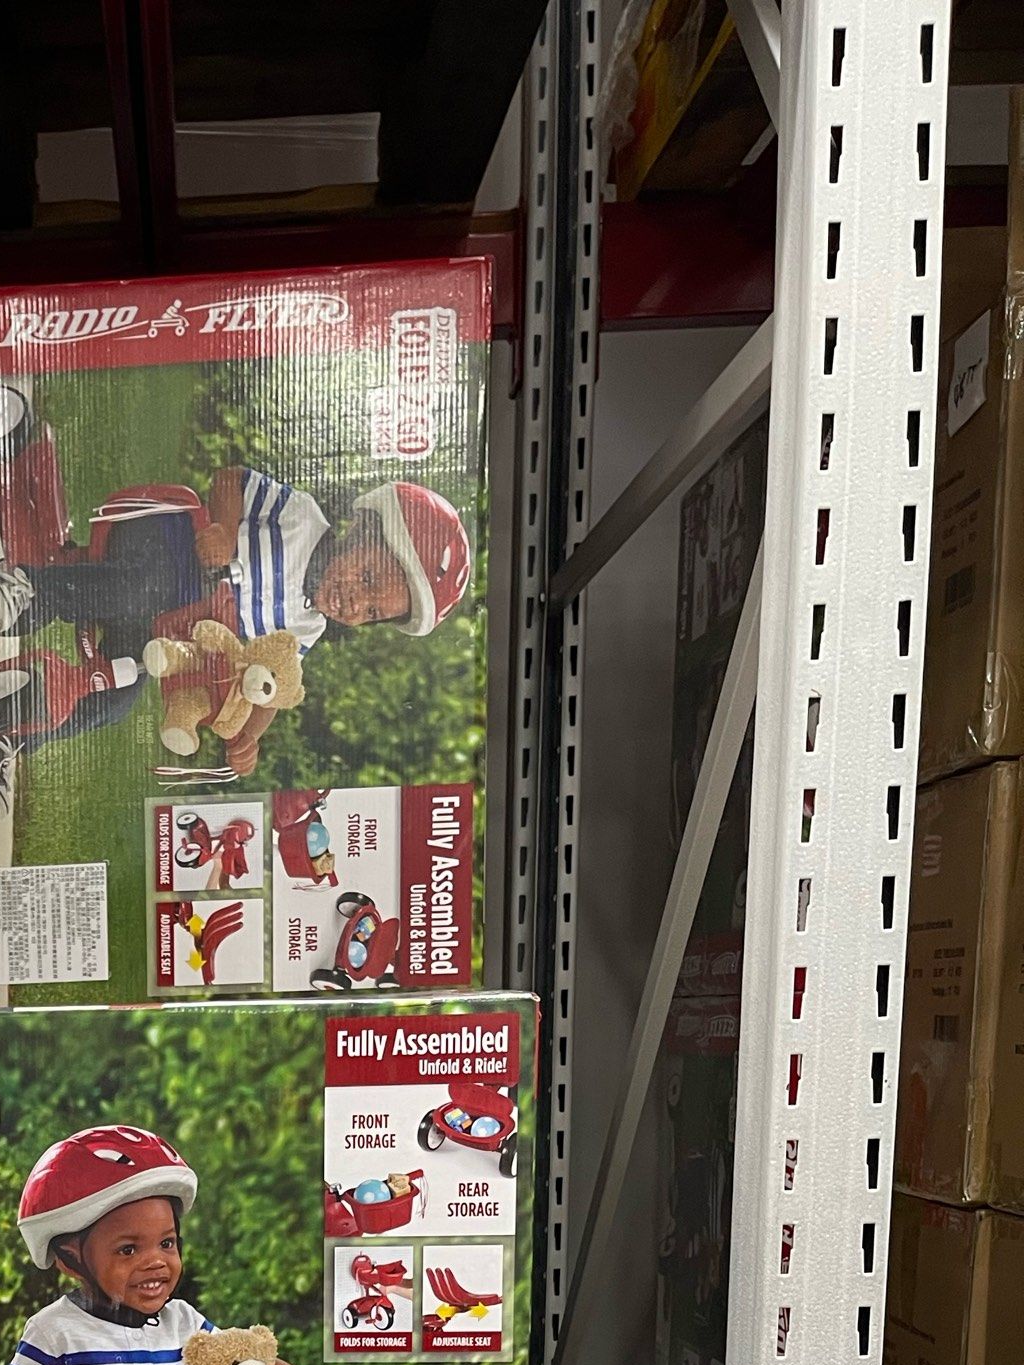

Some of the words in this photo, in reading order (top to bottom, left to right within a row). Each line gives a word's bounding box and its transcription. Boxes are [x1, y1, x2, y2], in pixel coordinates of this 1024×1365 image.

[159, 813, 170, 838] FOLDS
[347, 813, 361, 858] STORAGE
[365, 818, 378, 851] FRONT
[426, 795, 461, 850] Fully
[159, 840, 170, 853] FOR
[159, 853, 171, 885] STORAGE
[410, 884, 427, 929] Unfold
[430, 854, 461, 975] Assembled
[159, 913, 171, 954] ADJUSTABLE
[288, 917, 302, 962] STORAGE
[305, 925, 318, 952] REAR
[410, 929, 426, 940] &
[160, 954, 171, 975] SEAT
[409, 940, 426, 975] Ride!
[337, 1029, 387, 1061] Fully
[392, 1025, 509, 1057] Assembled
[419, 1057, 460, 1076] Unfold
[462, 1058, 473, 1075] &
[475, 1056, 507, 1074] Ride!
[352, 1114, 389, 1129] FRONT
[344, 1133, 396, 1149] STORAGE
[458, 1183, 489, 1198] REAR
[447, 1201, 500, 1218] STORAGE
[340, 1337, 360, 1348] FOLDS
[361, 1337, 375, 1348] FOR
[376, 1336, 407, 1348] STORAGE
[432, 1336, 473, 1348] ADJUSTABLE
[474, 1336, 491, 1347] SEAT
